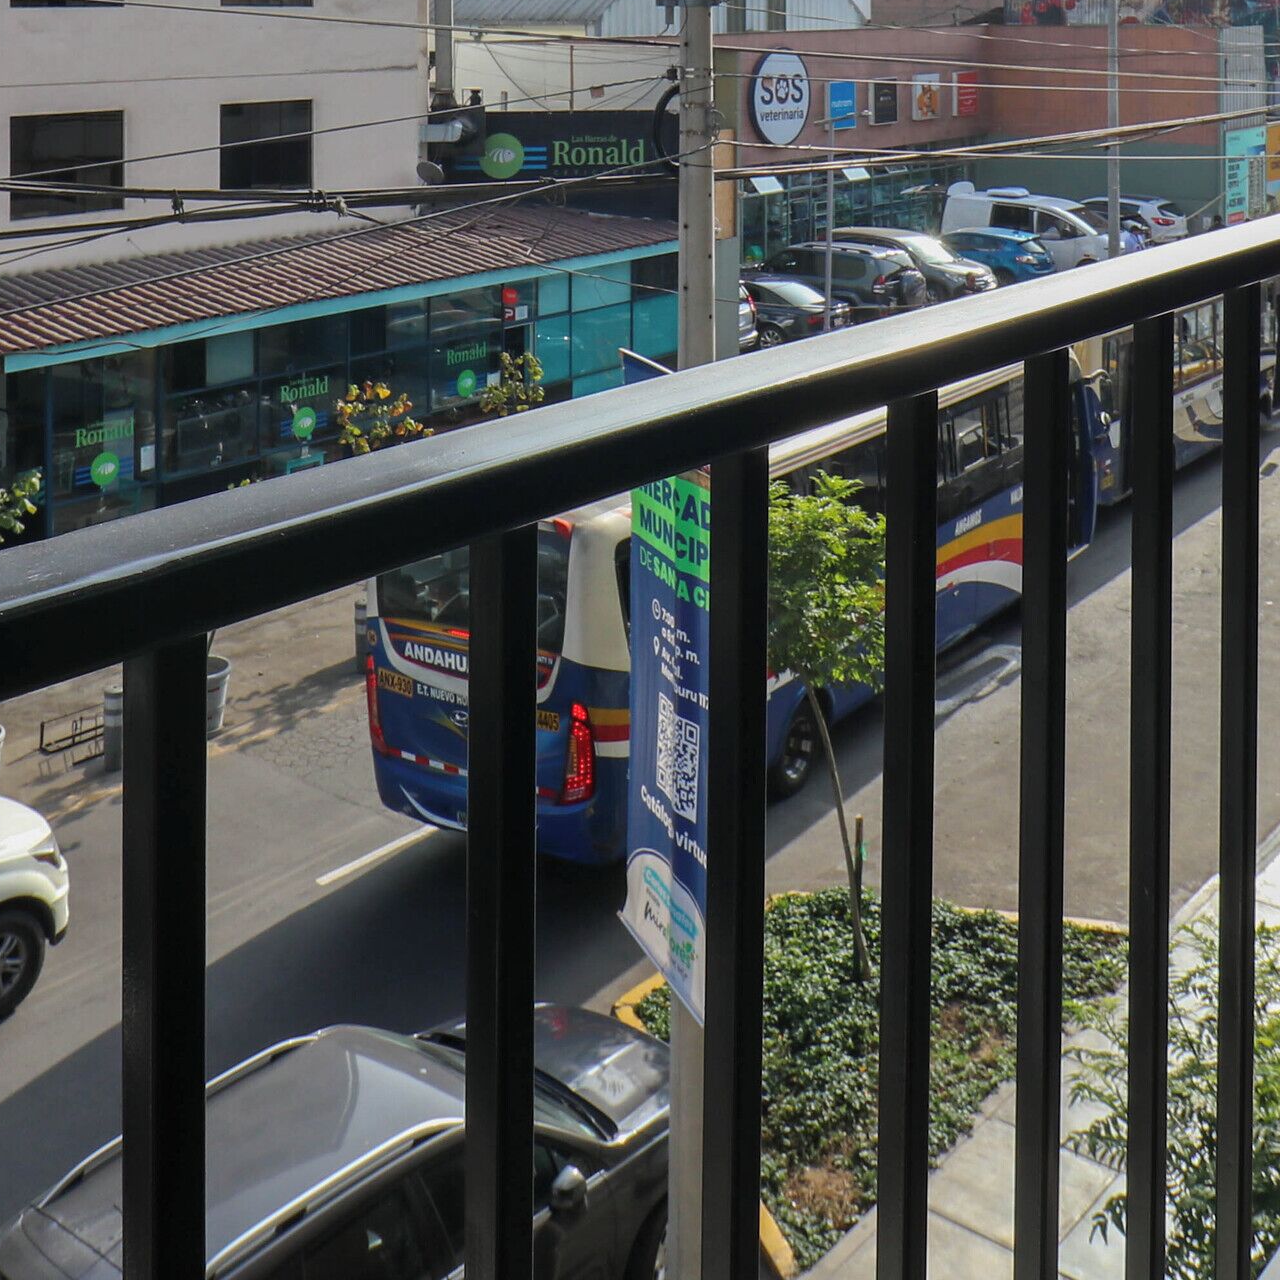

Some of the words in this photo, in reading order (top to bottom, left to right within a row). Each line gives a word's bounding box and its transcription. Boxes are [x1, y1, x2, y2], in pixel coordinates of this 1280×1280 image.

[760, 73, 804, 105] SOS
[759, 107, 804, 122] veterinaria
[552, 138, 645, 167] Ronald
[446, 341, 487, 366] Ronald
[280, 375, 329, 403] Ronald
[74, 416, 135, 448] Ronald
[640, 544, 652, 572] DE
[404, 642, 469, 673] ANDAHU
[379, 670, 412, 696] ANX-930
[430, 687, 455, 704] NUEVO
[456, 695, 469, 706] HO
